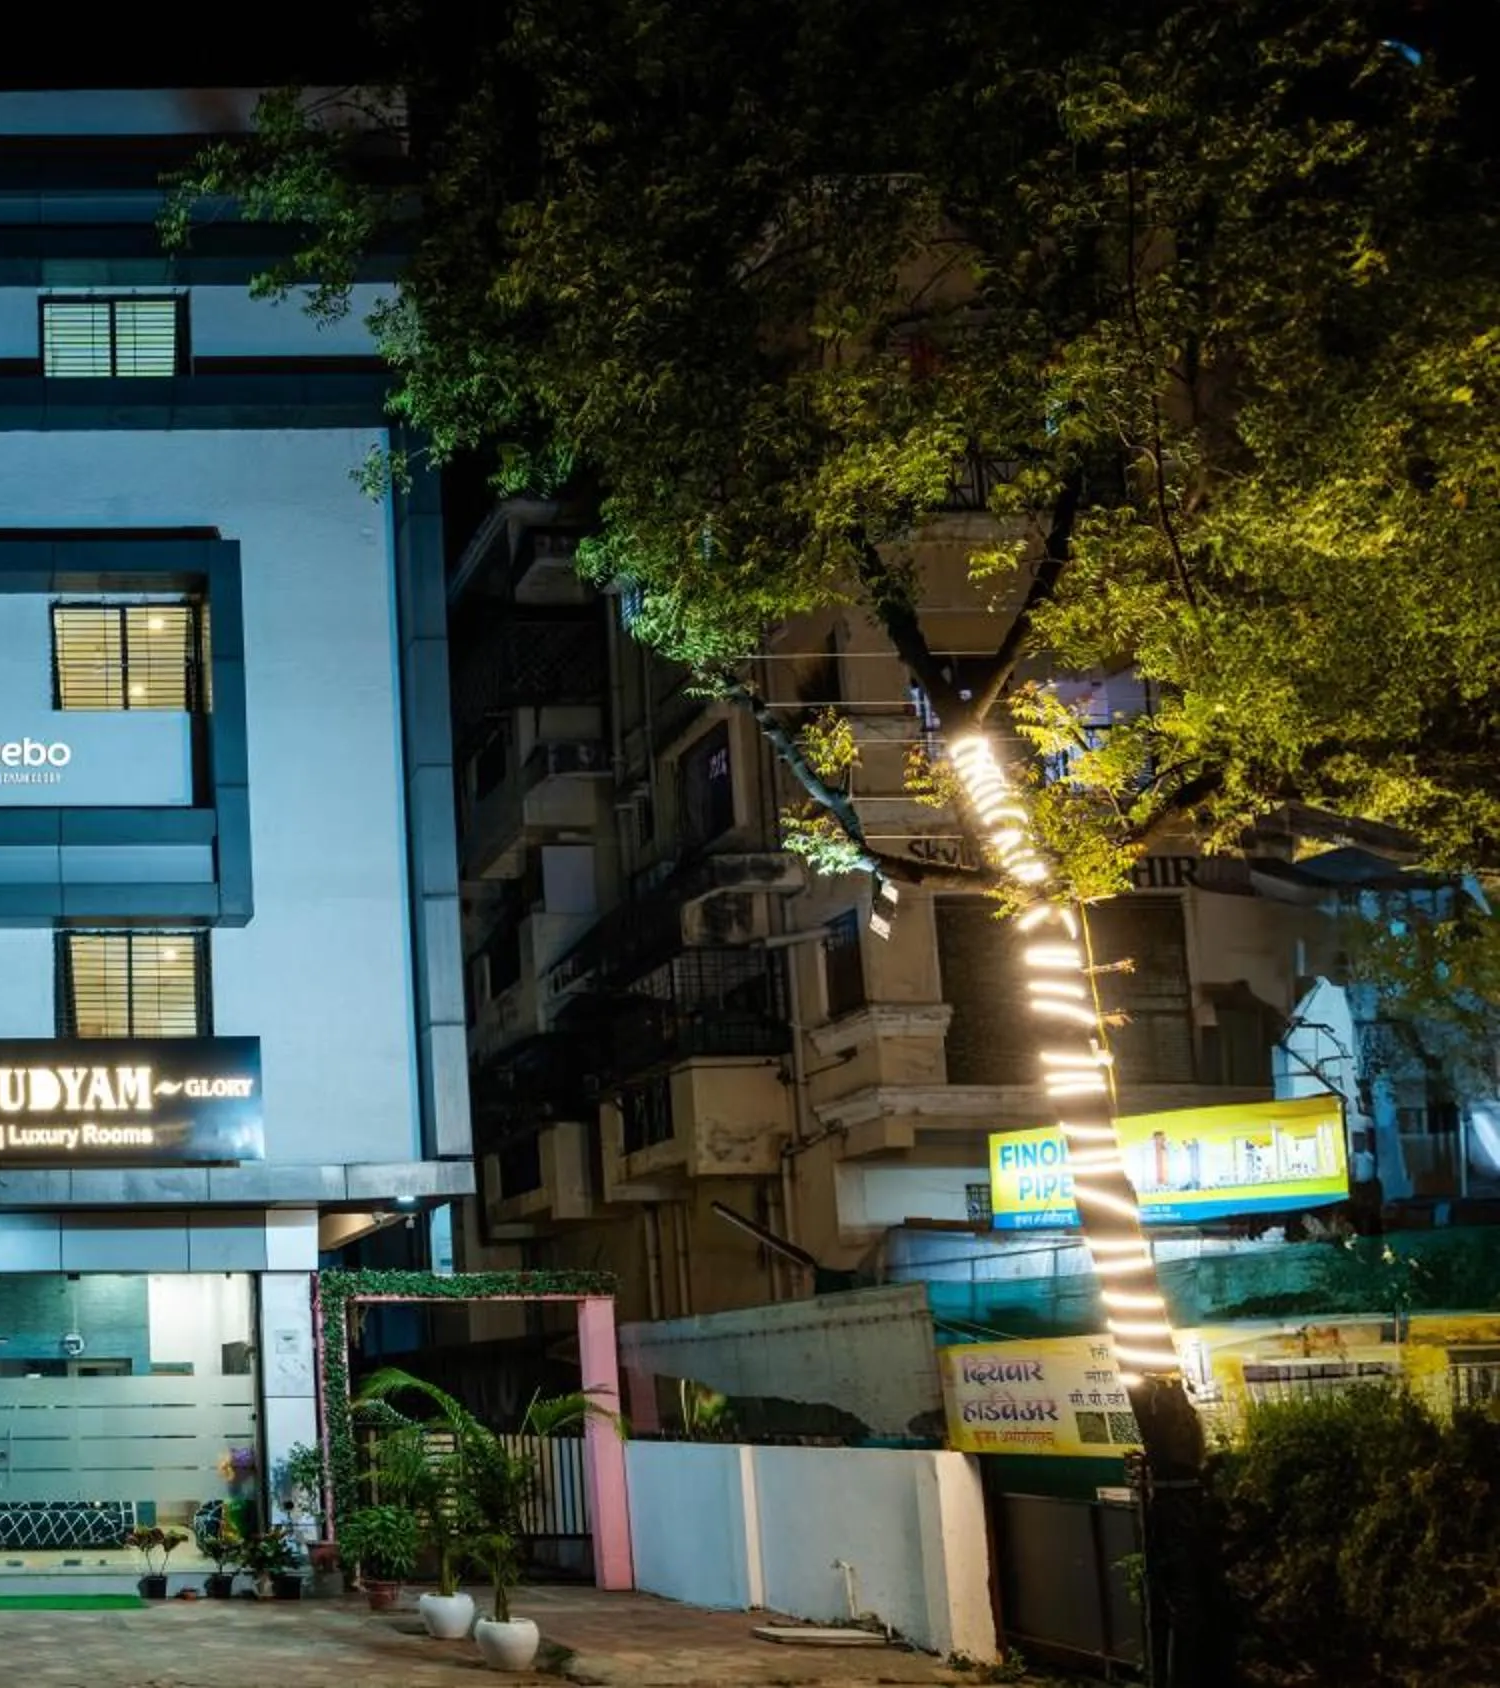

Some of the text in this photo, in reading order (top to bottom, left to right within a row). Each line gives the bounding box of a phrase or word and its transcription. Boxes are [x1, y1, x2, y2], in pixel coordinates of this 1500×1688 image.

[184, 1078, 253, 1098] GLORY
[8, 1124, 79, 1149] Luxury
[82, 1124, 154, 1145] Rooms
[1018, 1172, 1075, 1201] PIPE
